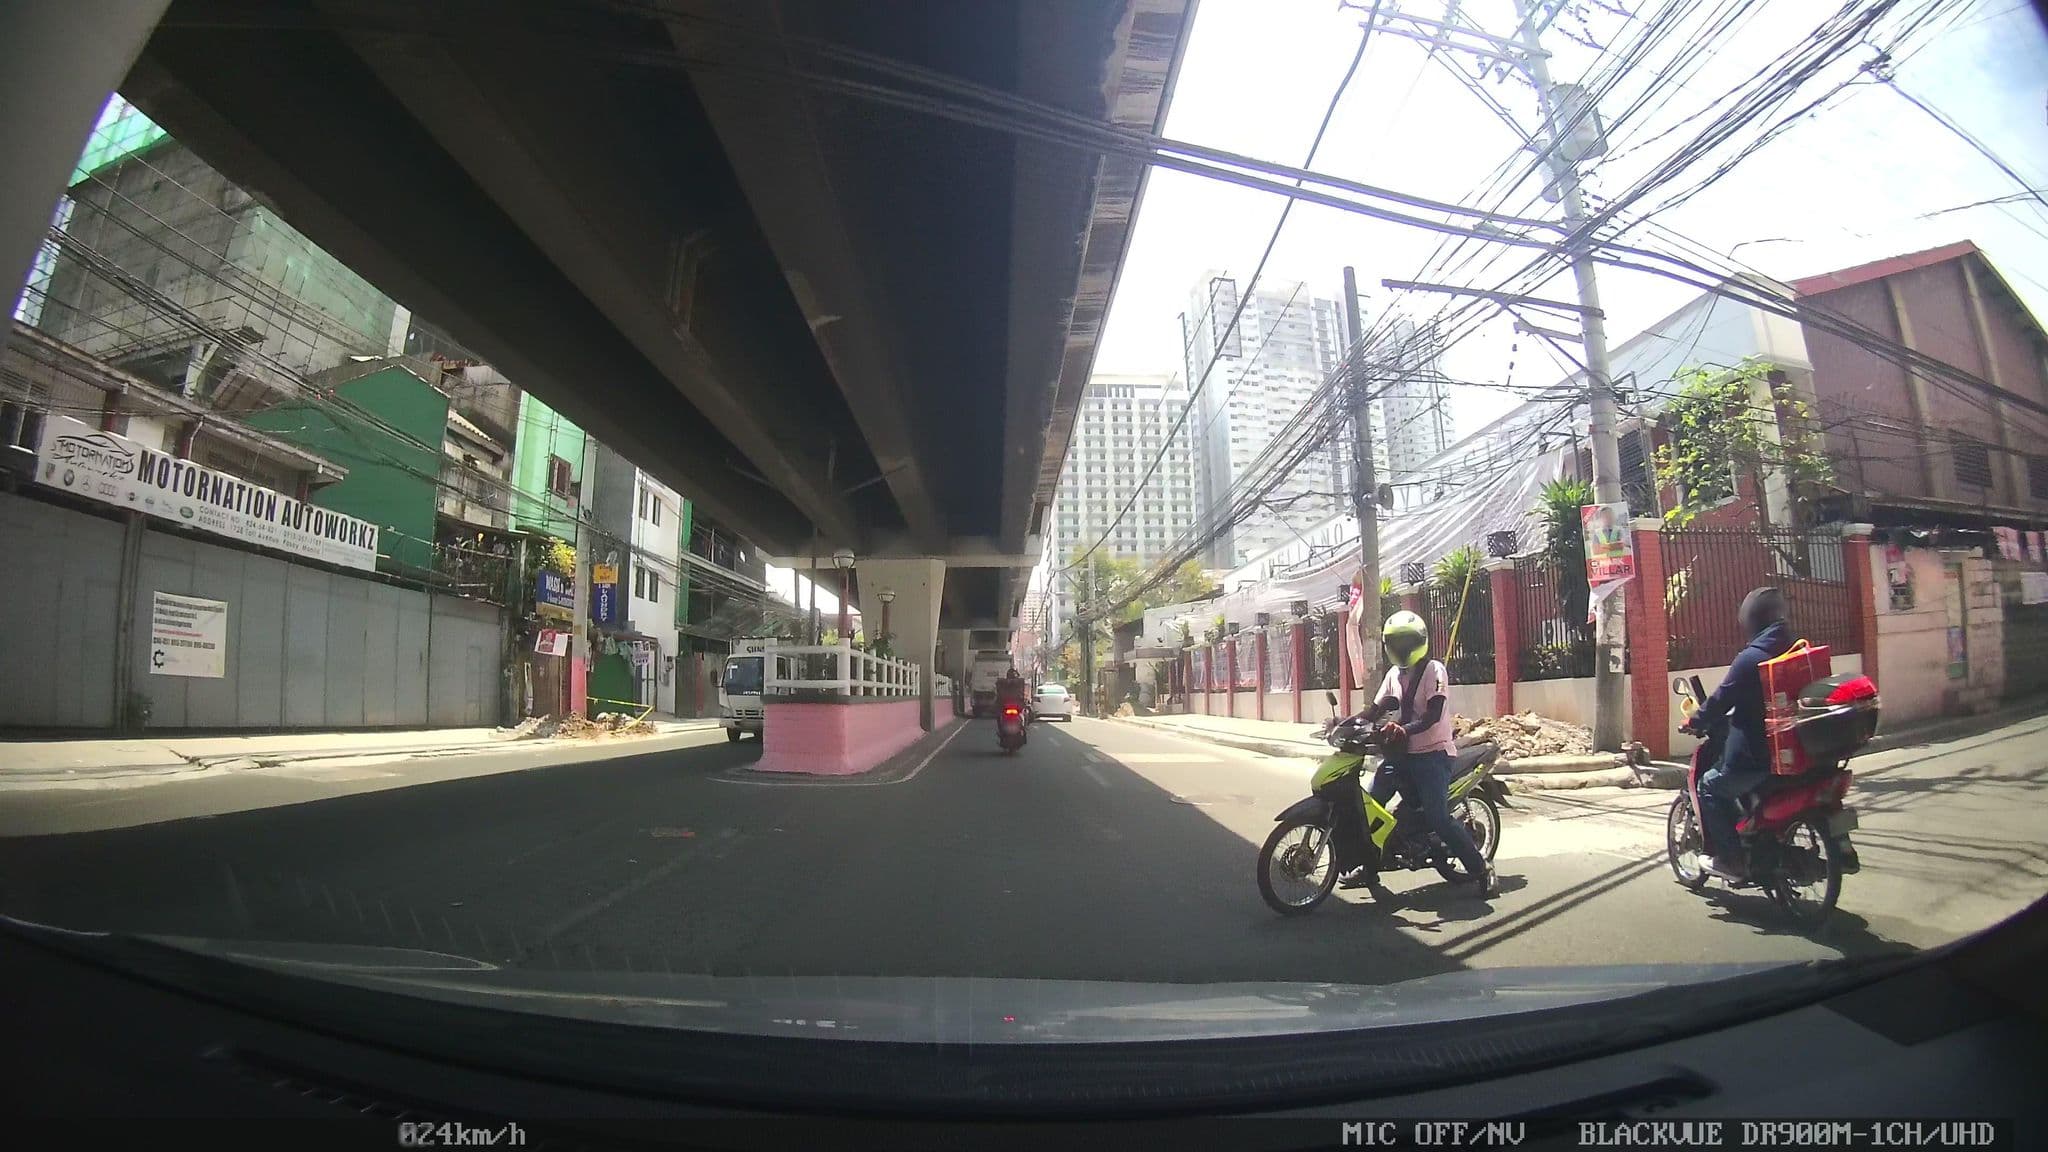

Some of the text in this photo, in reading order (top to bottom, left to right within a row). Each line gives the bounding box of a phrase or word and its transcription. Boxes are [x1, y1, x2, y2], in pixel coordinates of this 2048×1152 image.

[137, 450, 278, 522] MOTORNATION
[281, 500, 375, 551] AUTOWORKZ
[199, 506, 229, 521] CONTACT
[1590, 565, 1631, 577] VILLAR
